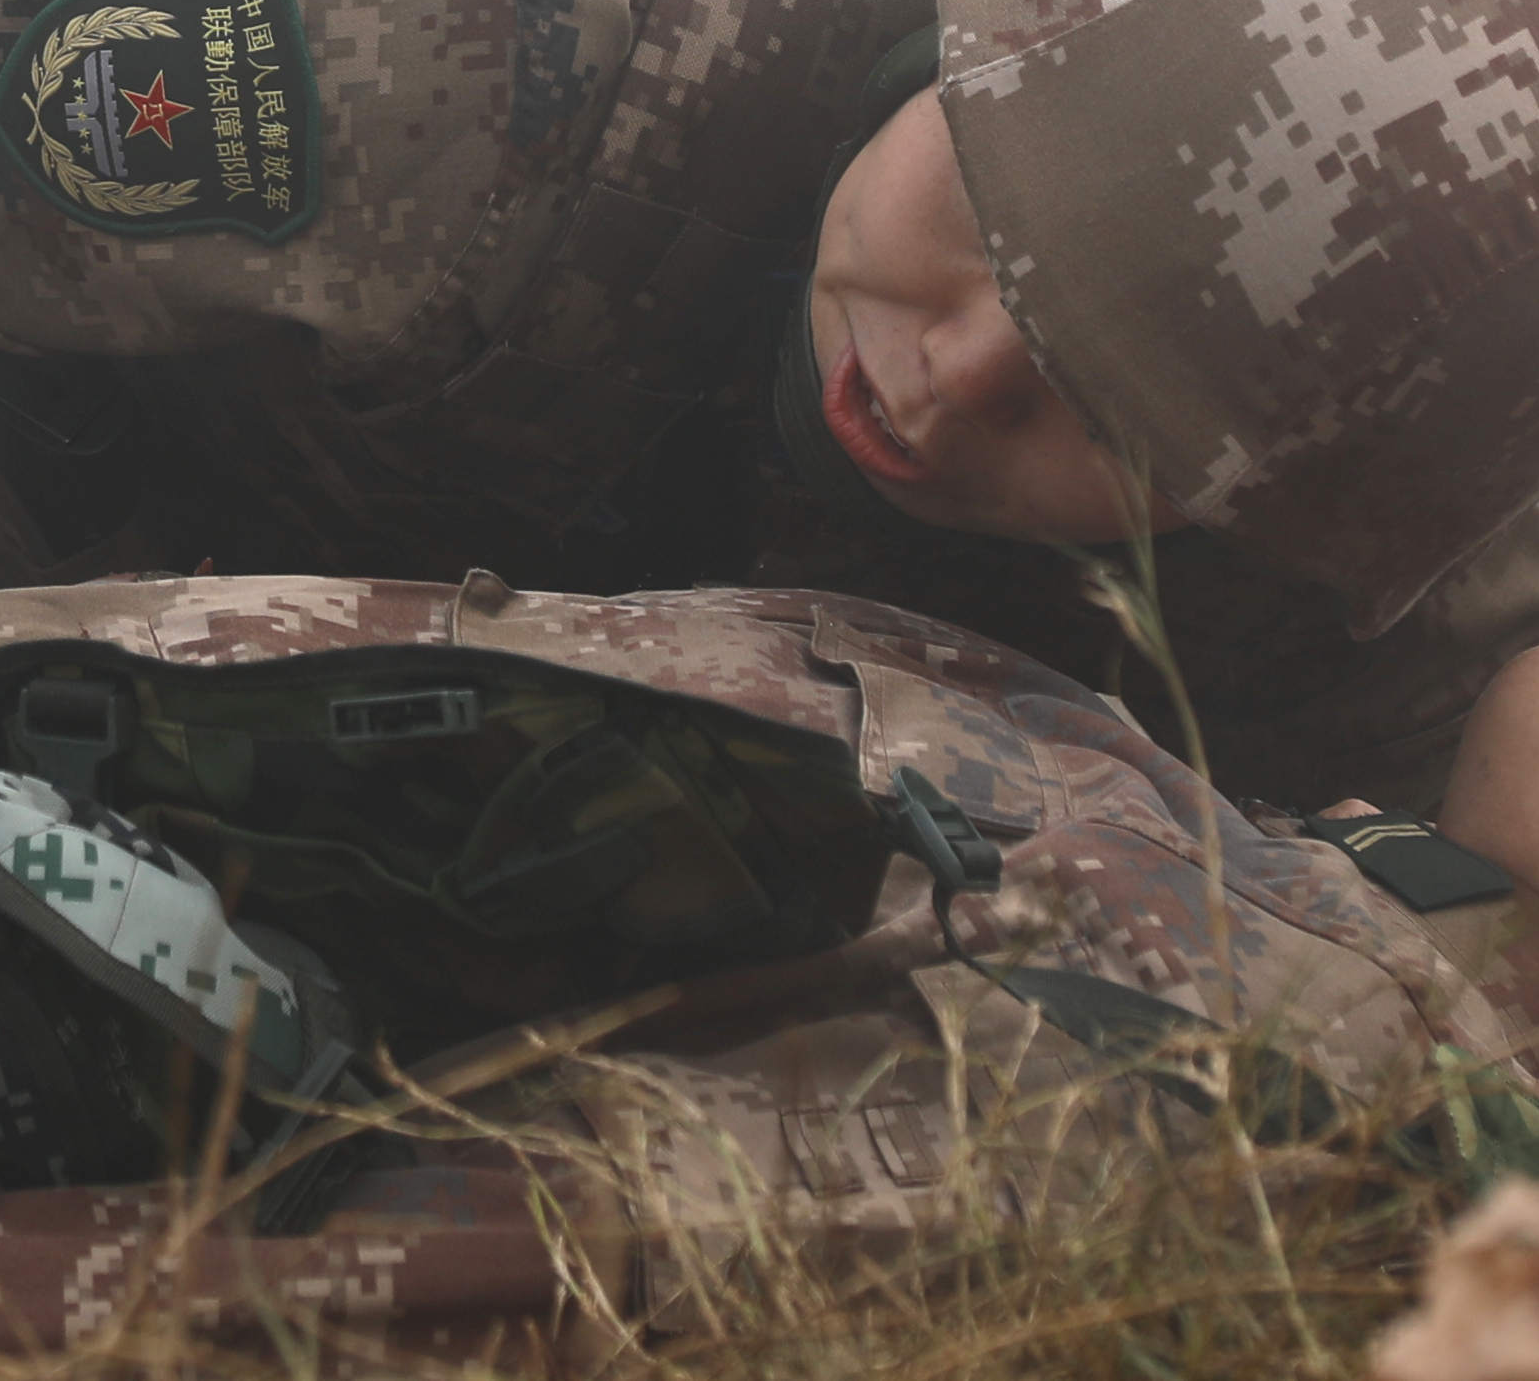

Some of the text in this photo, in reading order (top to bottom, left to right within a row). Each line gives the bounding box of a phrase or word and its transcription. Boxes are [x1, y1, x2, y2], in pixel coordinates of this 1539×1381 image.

[201, 6, 255, 201] 联勤保障部队
